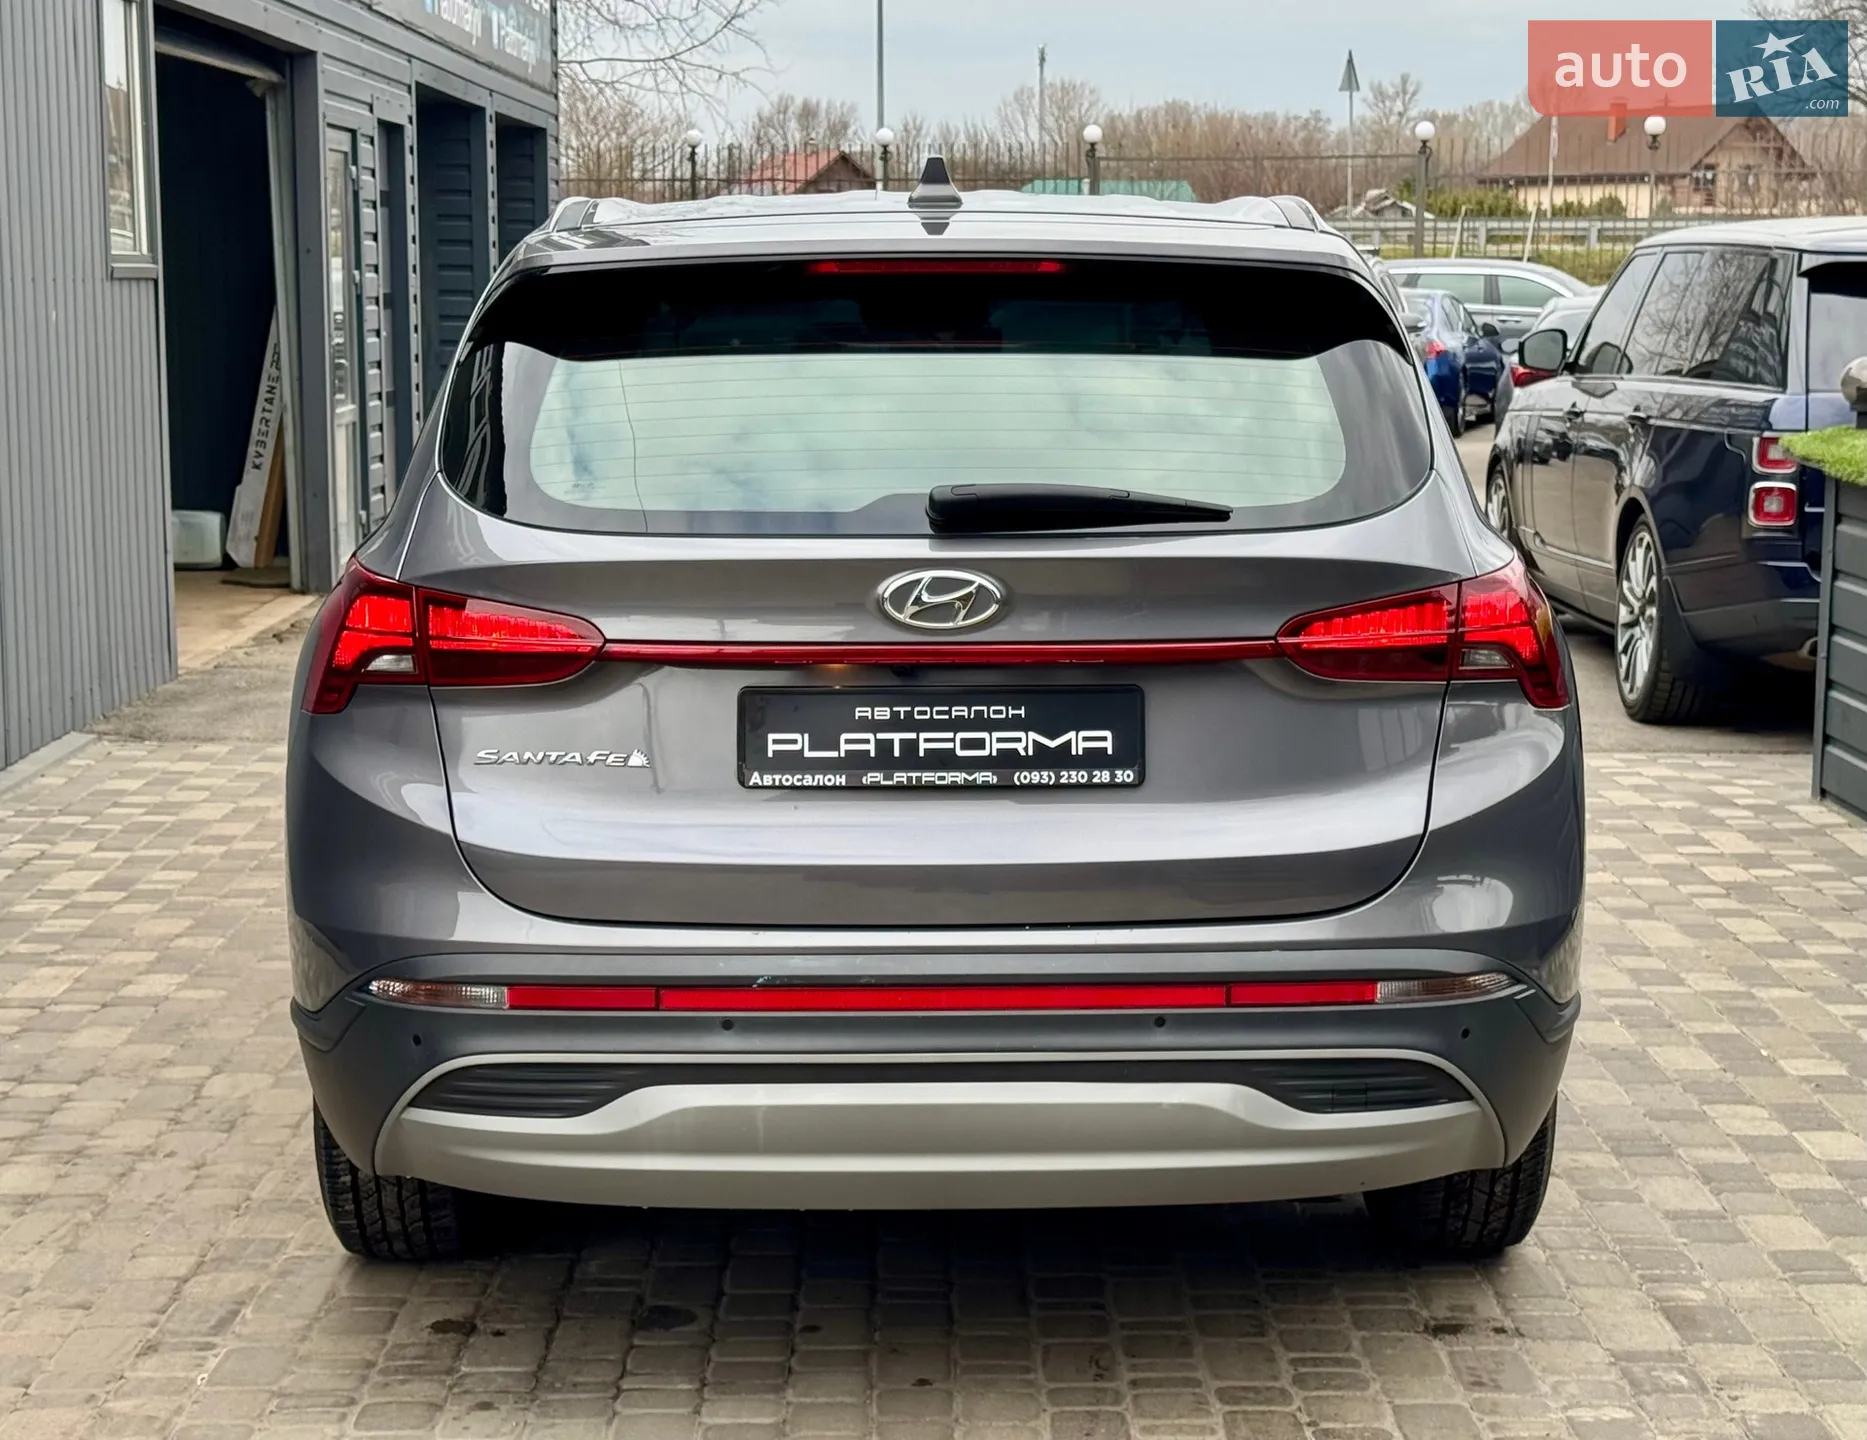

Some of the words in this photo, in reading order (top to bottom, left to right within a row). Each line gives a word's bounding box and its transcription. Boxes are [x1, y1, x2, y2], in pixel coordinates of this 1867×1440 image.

[855, 705, 1025, 720] АВТОСАЛОН
[767, 730, 1113, 758] PLATFORMA
[474, 748, 584, 766] SANTA
[586, 750, 628, 766] FE
[749, 771, 846, 786] Автосалон
[1013, 770, 1055, 785] (093)
[1059, 770, 1088, 783] 230
[1092, 770, 1110, 783] 28
[1114, 770, 1134, 783] 30
